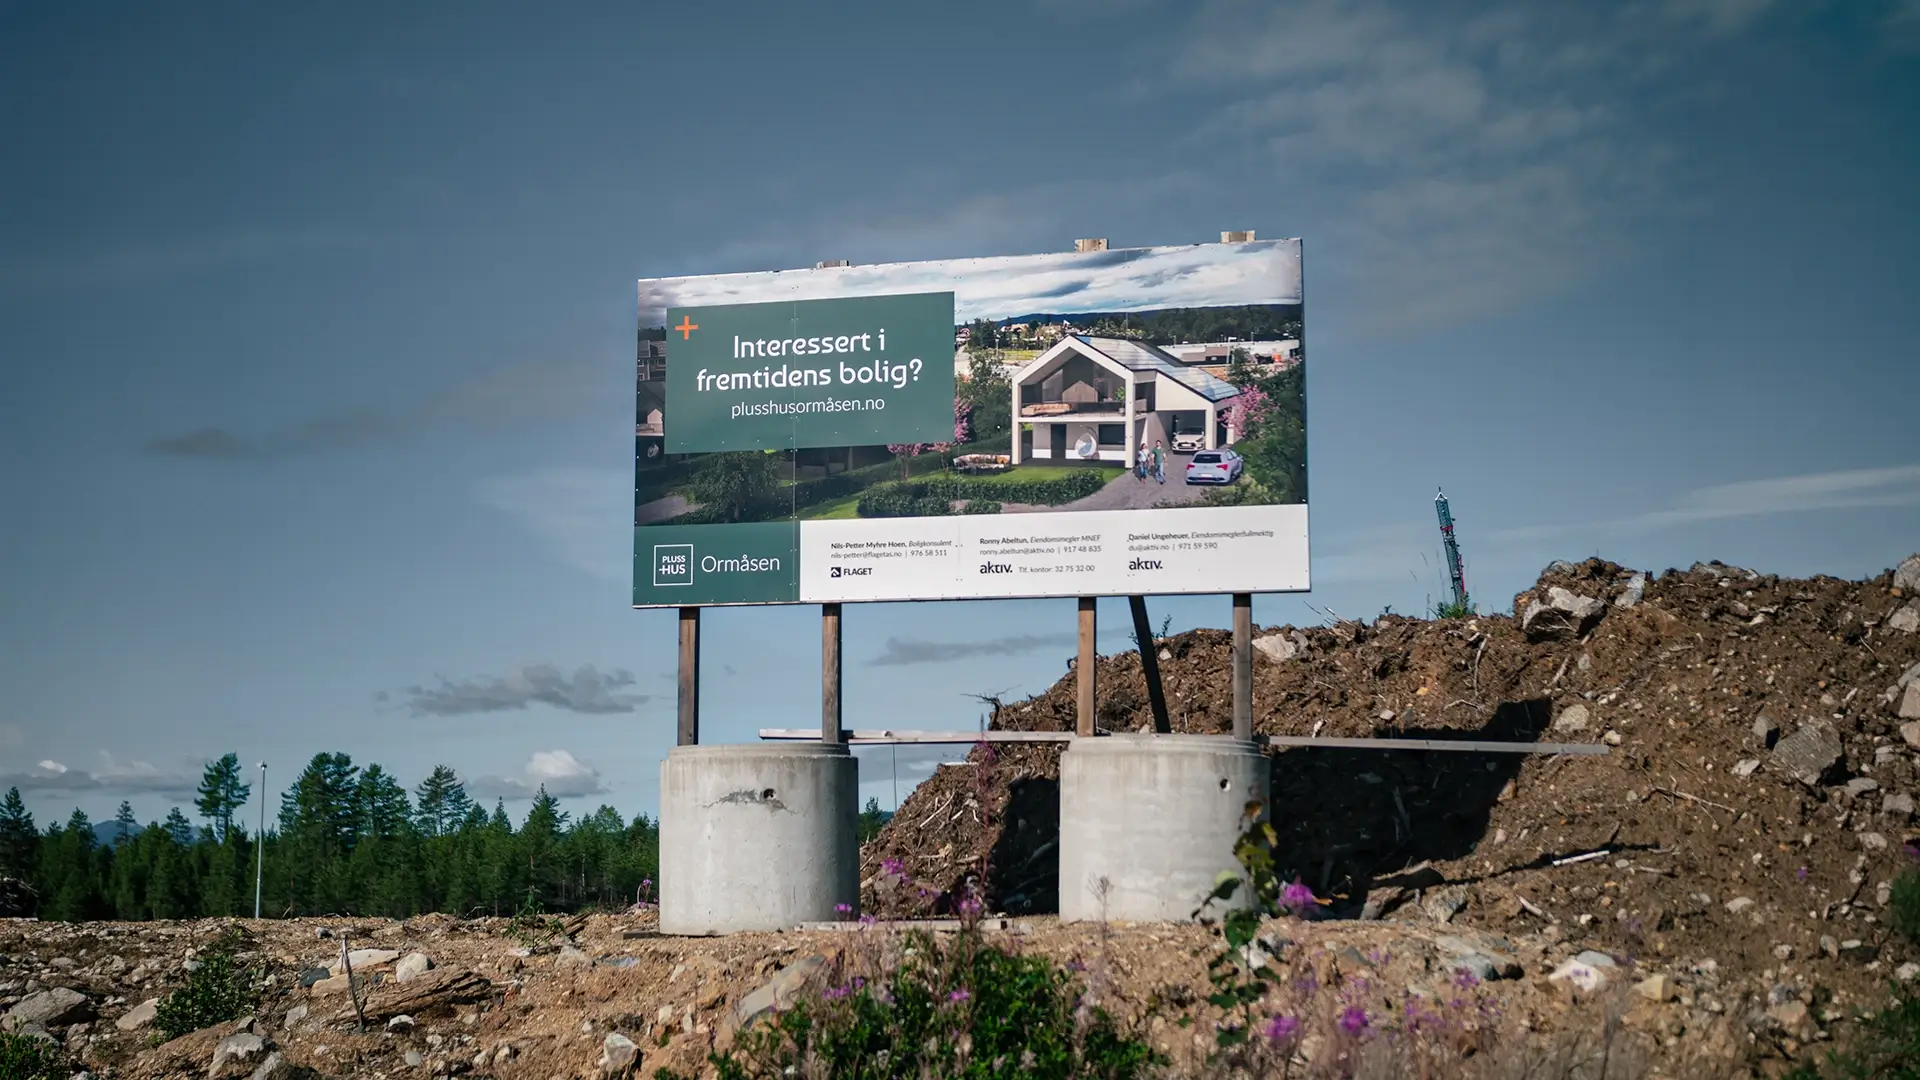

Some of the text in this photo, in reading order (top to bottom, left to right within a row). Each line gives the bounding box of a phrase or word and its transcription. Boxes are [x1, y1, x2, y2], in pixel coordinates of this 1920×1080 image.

[734, 328, 885, 358] Interessert i
[696, 358, 922, 391] fremtidens bolig?
[731, 397, 885, 419] plusshusormåsen.no
[662, 555, 686, 563] PLUSS
[701, 554, 780, 572] Ormåsen
[844, 568, 872, 576] FLAGET
